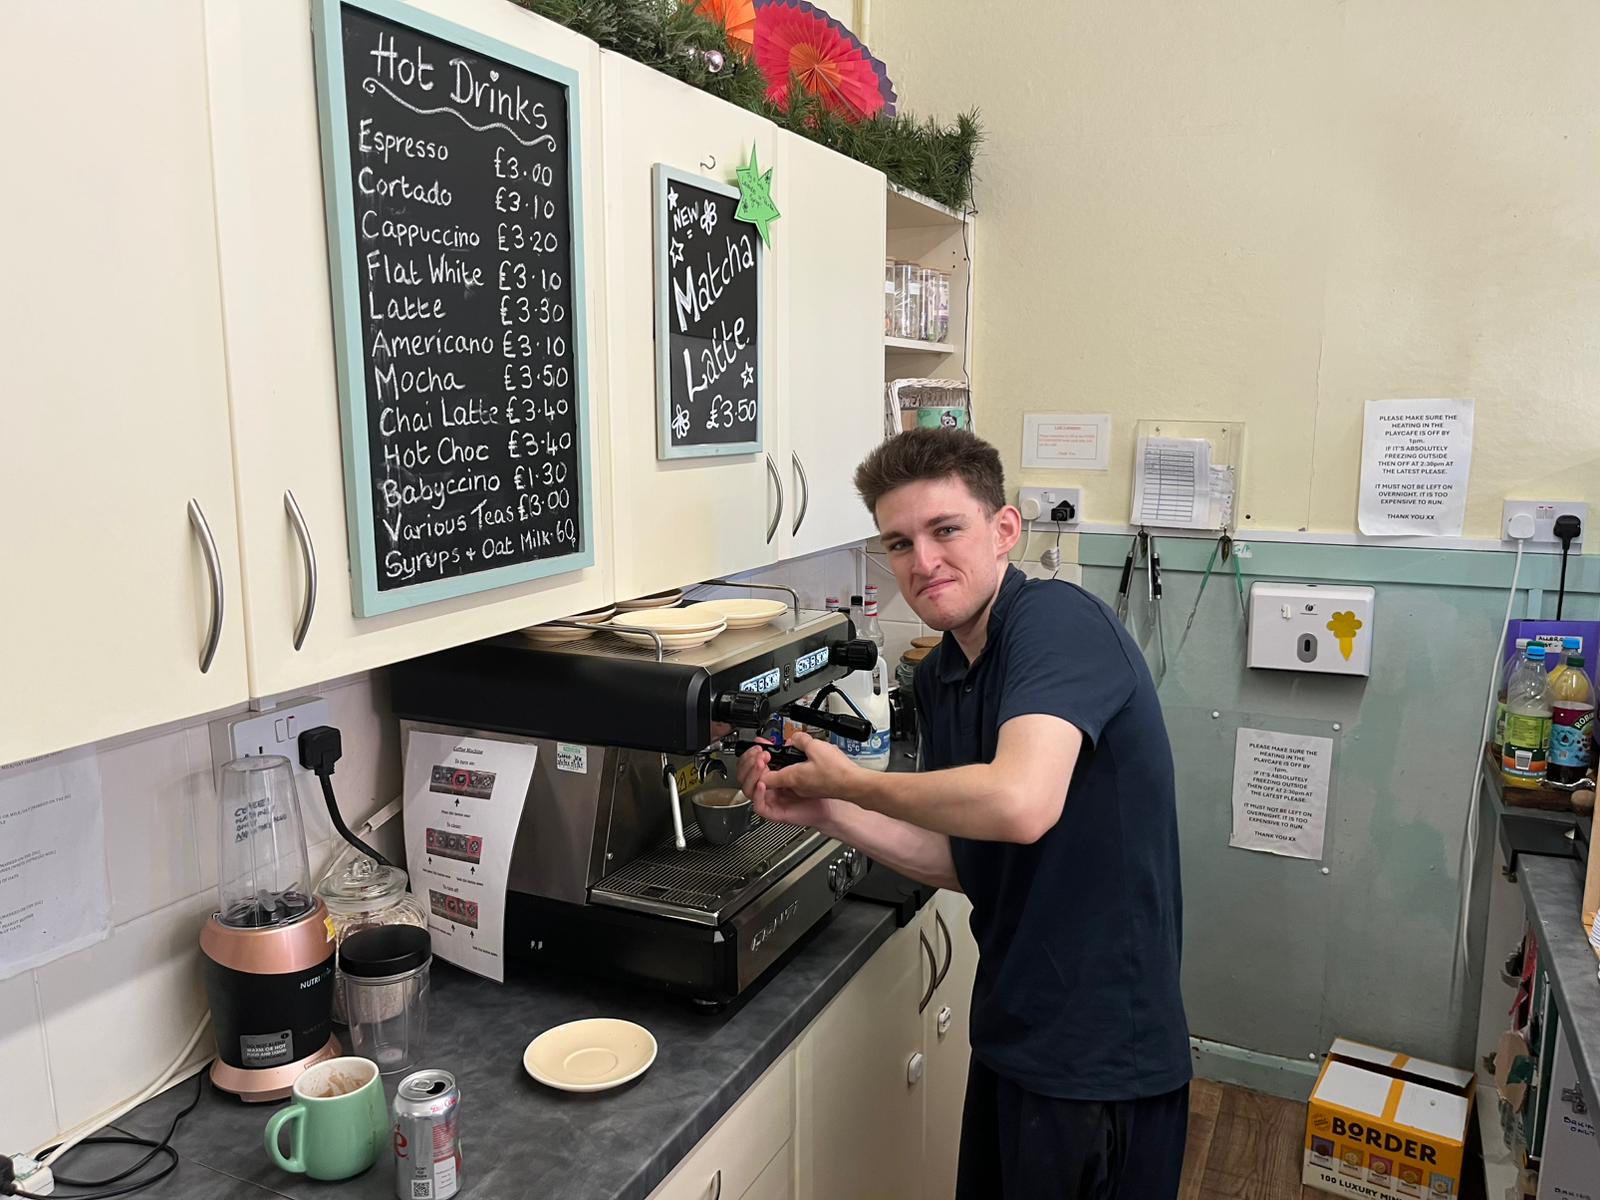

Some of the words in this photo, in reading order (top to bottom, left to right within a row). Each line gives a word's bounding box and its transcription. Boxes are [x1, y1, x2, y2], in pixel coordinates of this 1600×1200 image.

[370, 31, 435, 90] Hot
[449, 57, 548, 130] Drinks
[358, 118, 449, 164] Espresso
[494, 146, 552, 187] £3.00
[358, 166, 452, 206] Cortado
[495, 186, 555, 219] £3.10
[361, 209, 480, 247] Cappuccino
[497, 222, 558, 252] £3.20
[673, 200, 698, 232] NEW
[366, 249, 423, 286] Flat
[428, 252, 485, 287] White
[499, 260, 562, 291] £3.10
[673, 234, 754, 333] Matcha
[369, 290, 446, 320] Latte
[500, 294, 565, 326] £3.30
[372, 328, 494, 358] Americano
[503, 330, 566, 358] £3.10
[682, 316, 750, 402] Latte
[374, 362, 466, 401] Mocha
[503, 364, 569, 391] £3.50
[379, 401, 432, 437] Chai
[441, 397, 499, 427] Latte
[506, 396, 568, 424] £3.40
[706, 393, 757, 430] £3.50
[384, 440, 431, 469] Hot
[437, 438, 489, 463] Choc
[508, 430, 572, 458] £3.40
[382, 468, 501, 510] Babyccino
[514, 462, 567, 490] £1.30
[382, 512, 467, 542] Various
[470, 499, 514, 530] Teas
[384, 547, 460, 580] Syrups
[482, 536, 514, 559] Oat
[520, 528, 550, 552] Milk
[1332, 1116, 1437, 1165] BORDER
[1320, 1174, 1336, 1184] 100
[1340, 1180, 1378, 1197] LUXURY
